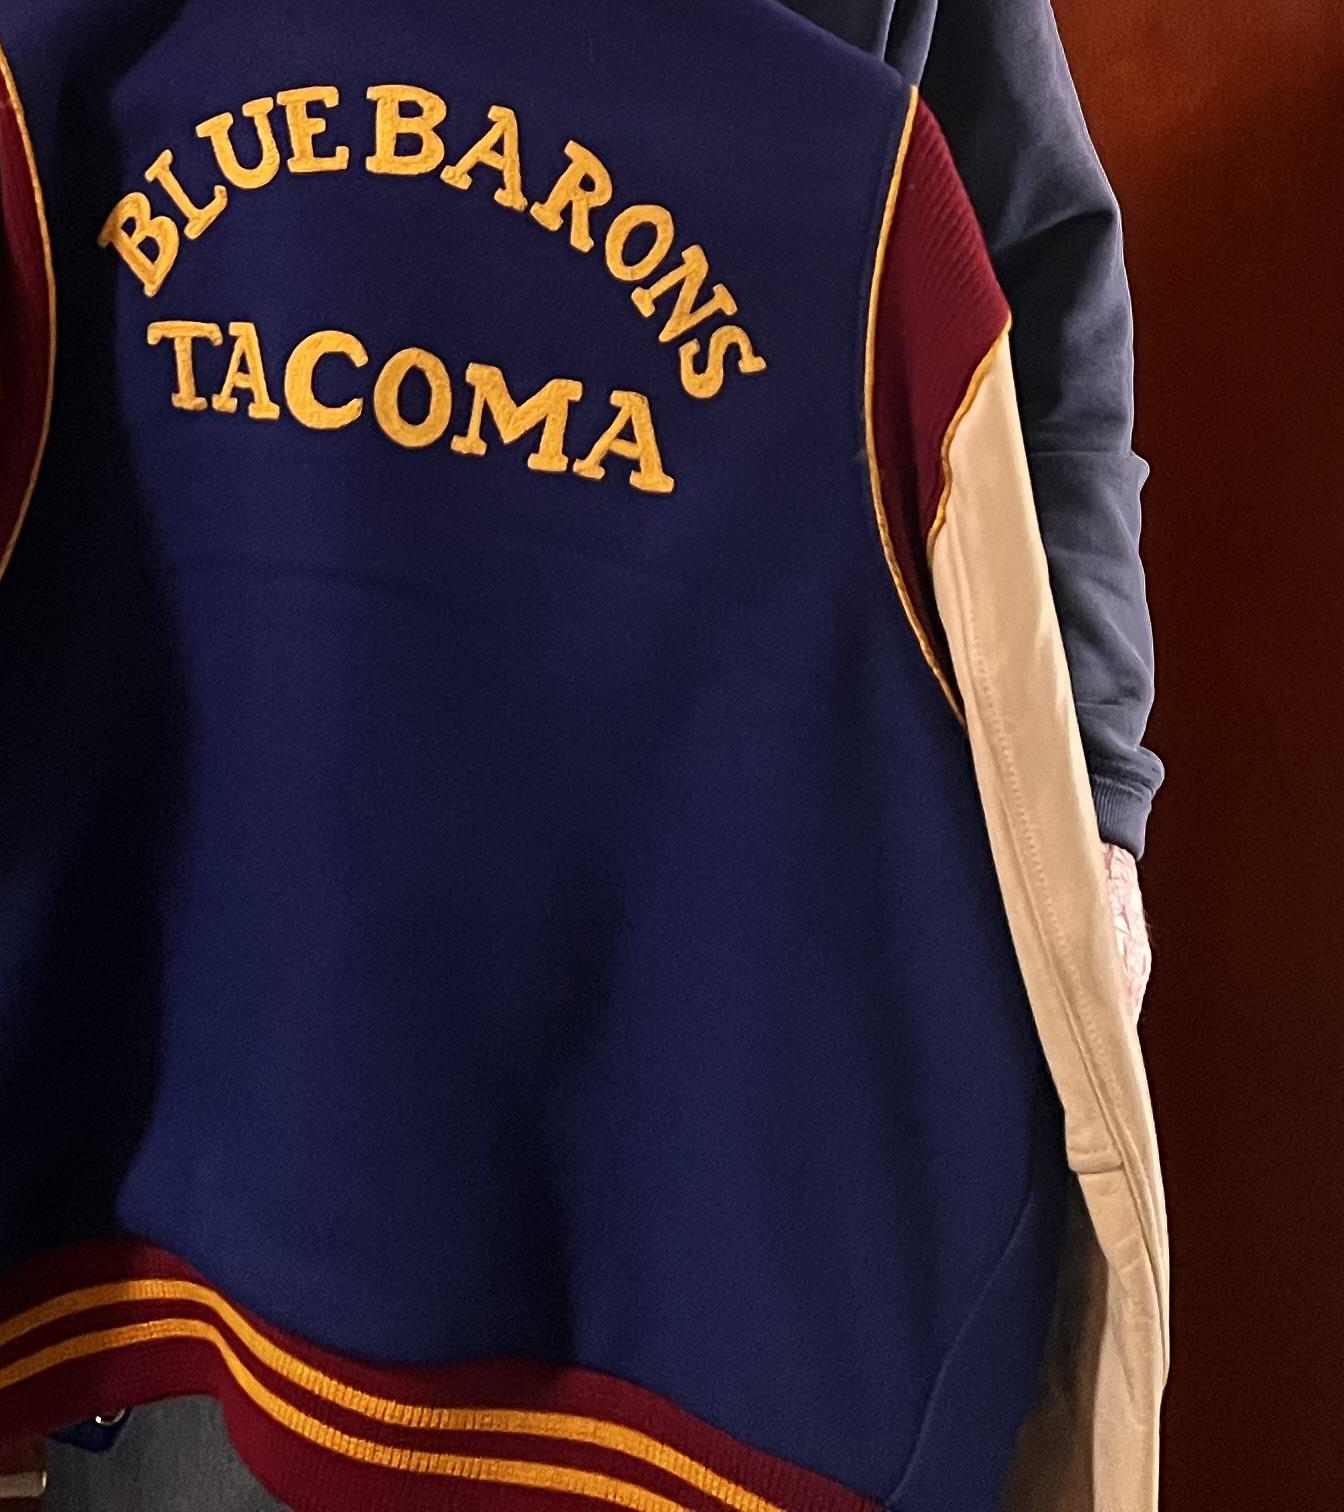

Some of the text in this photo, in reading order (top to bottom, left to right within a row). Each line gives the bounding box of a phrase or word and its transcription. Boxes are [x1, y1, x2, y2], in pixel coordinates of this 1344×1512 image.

[97, 84, 767, 399] BLUE BARONS
[147, 320, 675, 494] TACOMA
